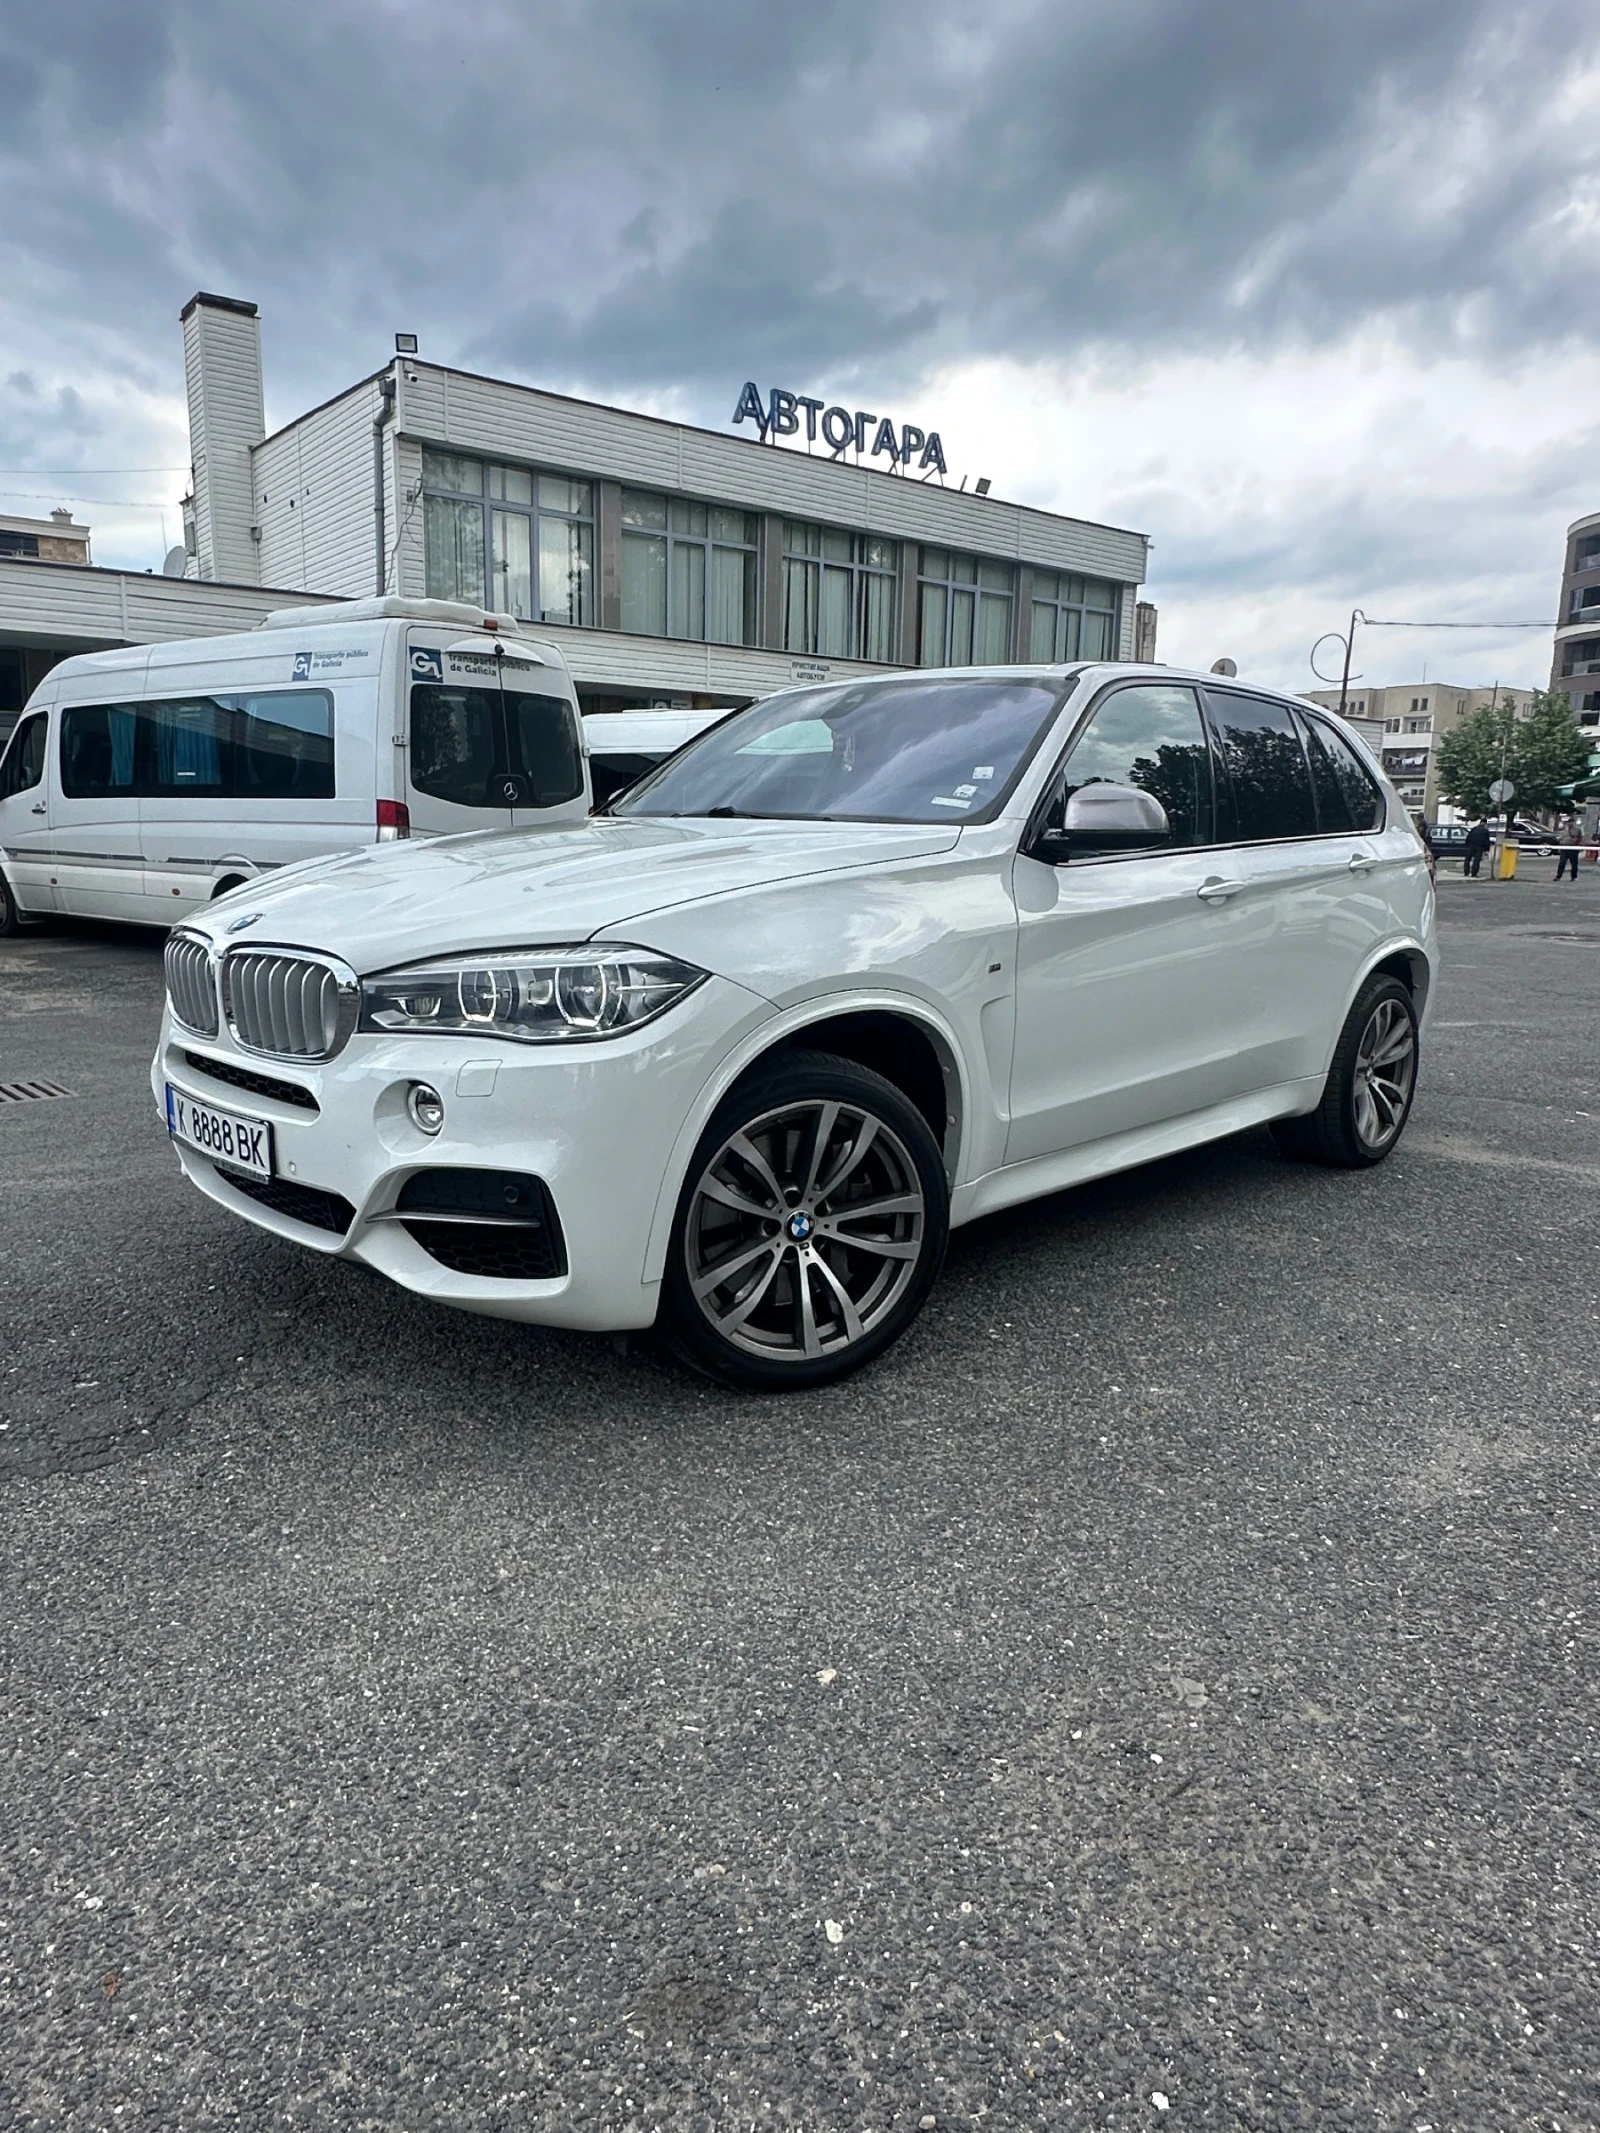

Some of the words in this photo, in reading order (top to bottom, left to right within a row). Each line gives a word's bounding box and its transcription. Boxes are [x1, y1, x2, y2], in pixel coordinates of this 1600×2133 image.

[732, 382, 948, 474] АВТОГАРА
[450, 663, 462, 672] de
[465, 664, 497, 677] Galicia
[192, 1107, 234, 1156] 8888
